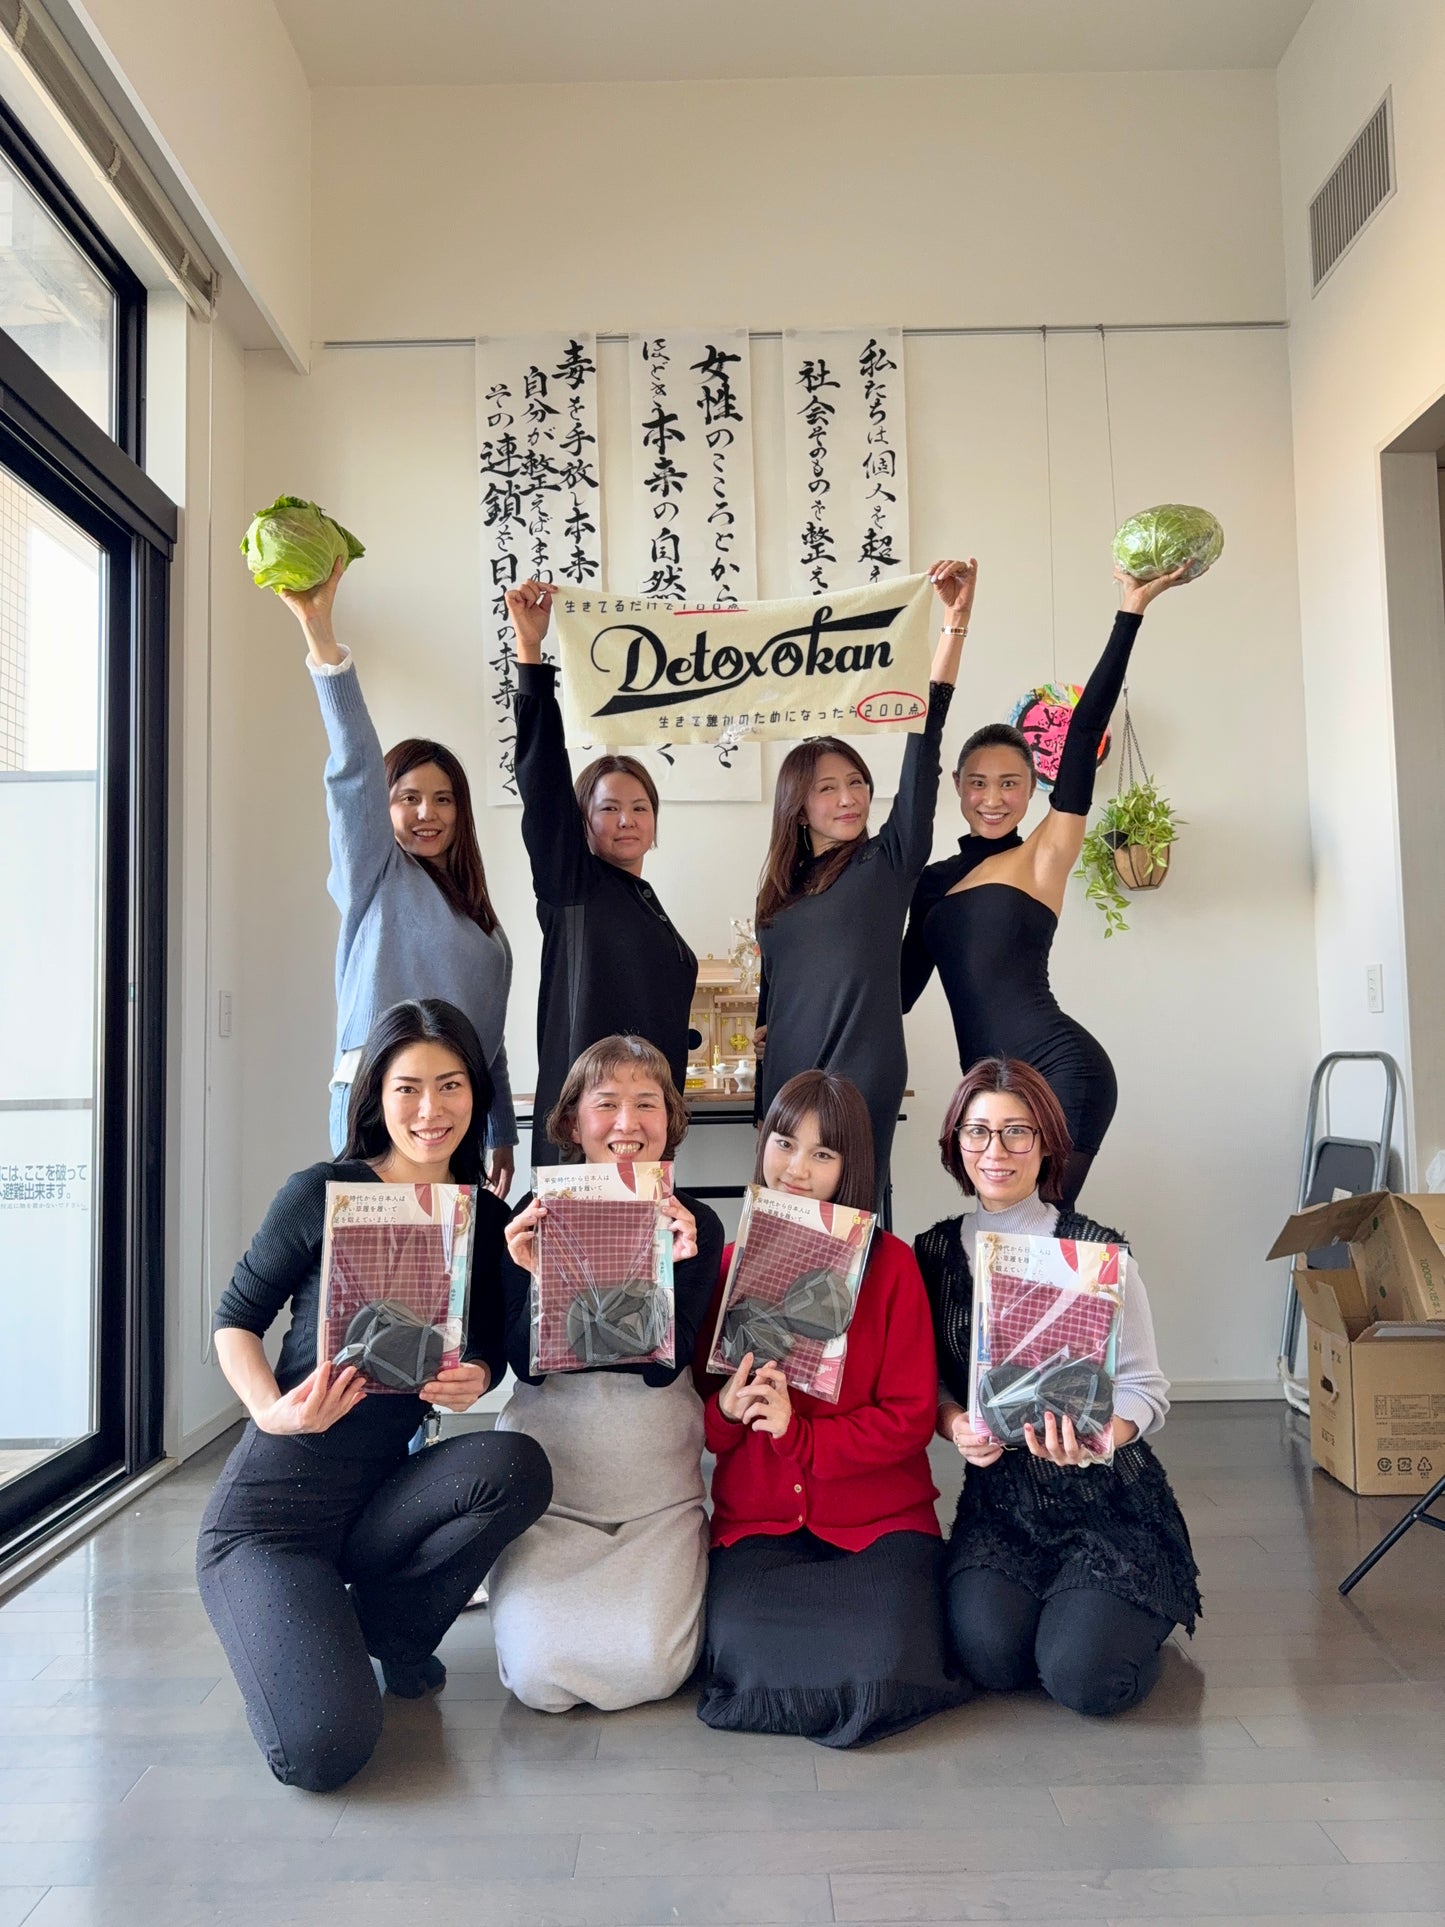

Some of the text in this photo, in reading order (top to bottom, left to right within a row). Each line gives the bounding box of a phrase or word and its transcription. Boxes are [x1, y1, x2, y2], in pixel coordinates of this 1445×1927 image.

[796, 358, 841, 596] 社会そのものを整え
[590, 604, 894, 693] Detoxokan
